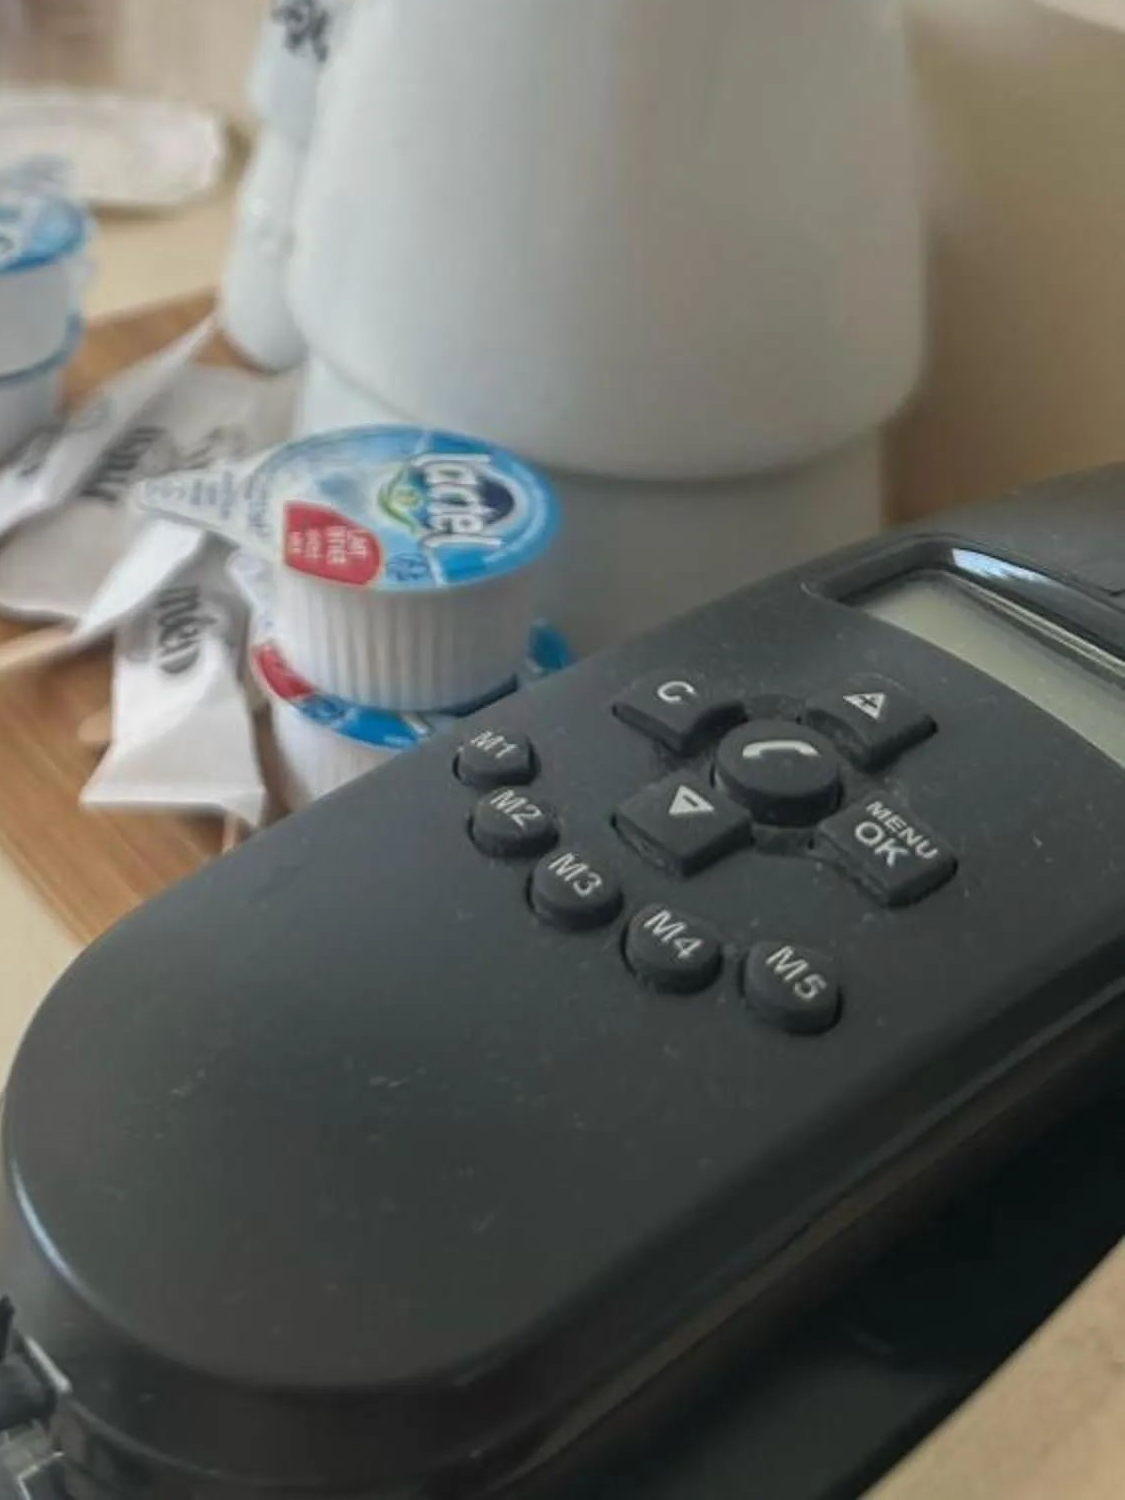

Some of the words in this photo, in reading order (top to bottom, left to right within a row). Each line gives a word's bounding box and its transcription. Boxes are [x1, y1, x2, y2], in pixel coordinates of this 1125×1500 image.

[657, 680, 696, 702] C
[469, 728, 517, 759] M1
[489, 787, 541, 828] M2
[865, 800, 939, 860] MENU
[854, 820, 910, 866] OK
[548, 851, 603, 898] M3
[643, 909, 704, 959] M4
[765, 945, 828, 1002] M5
